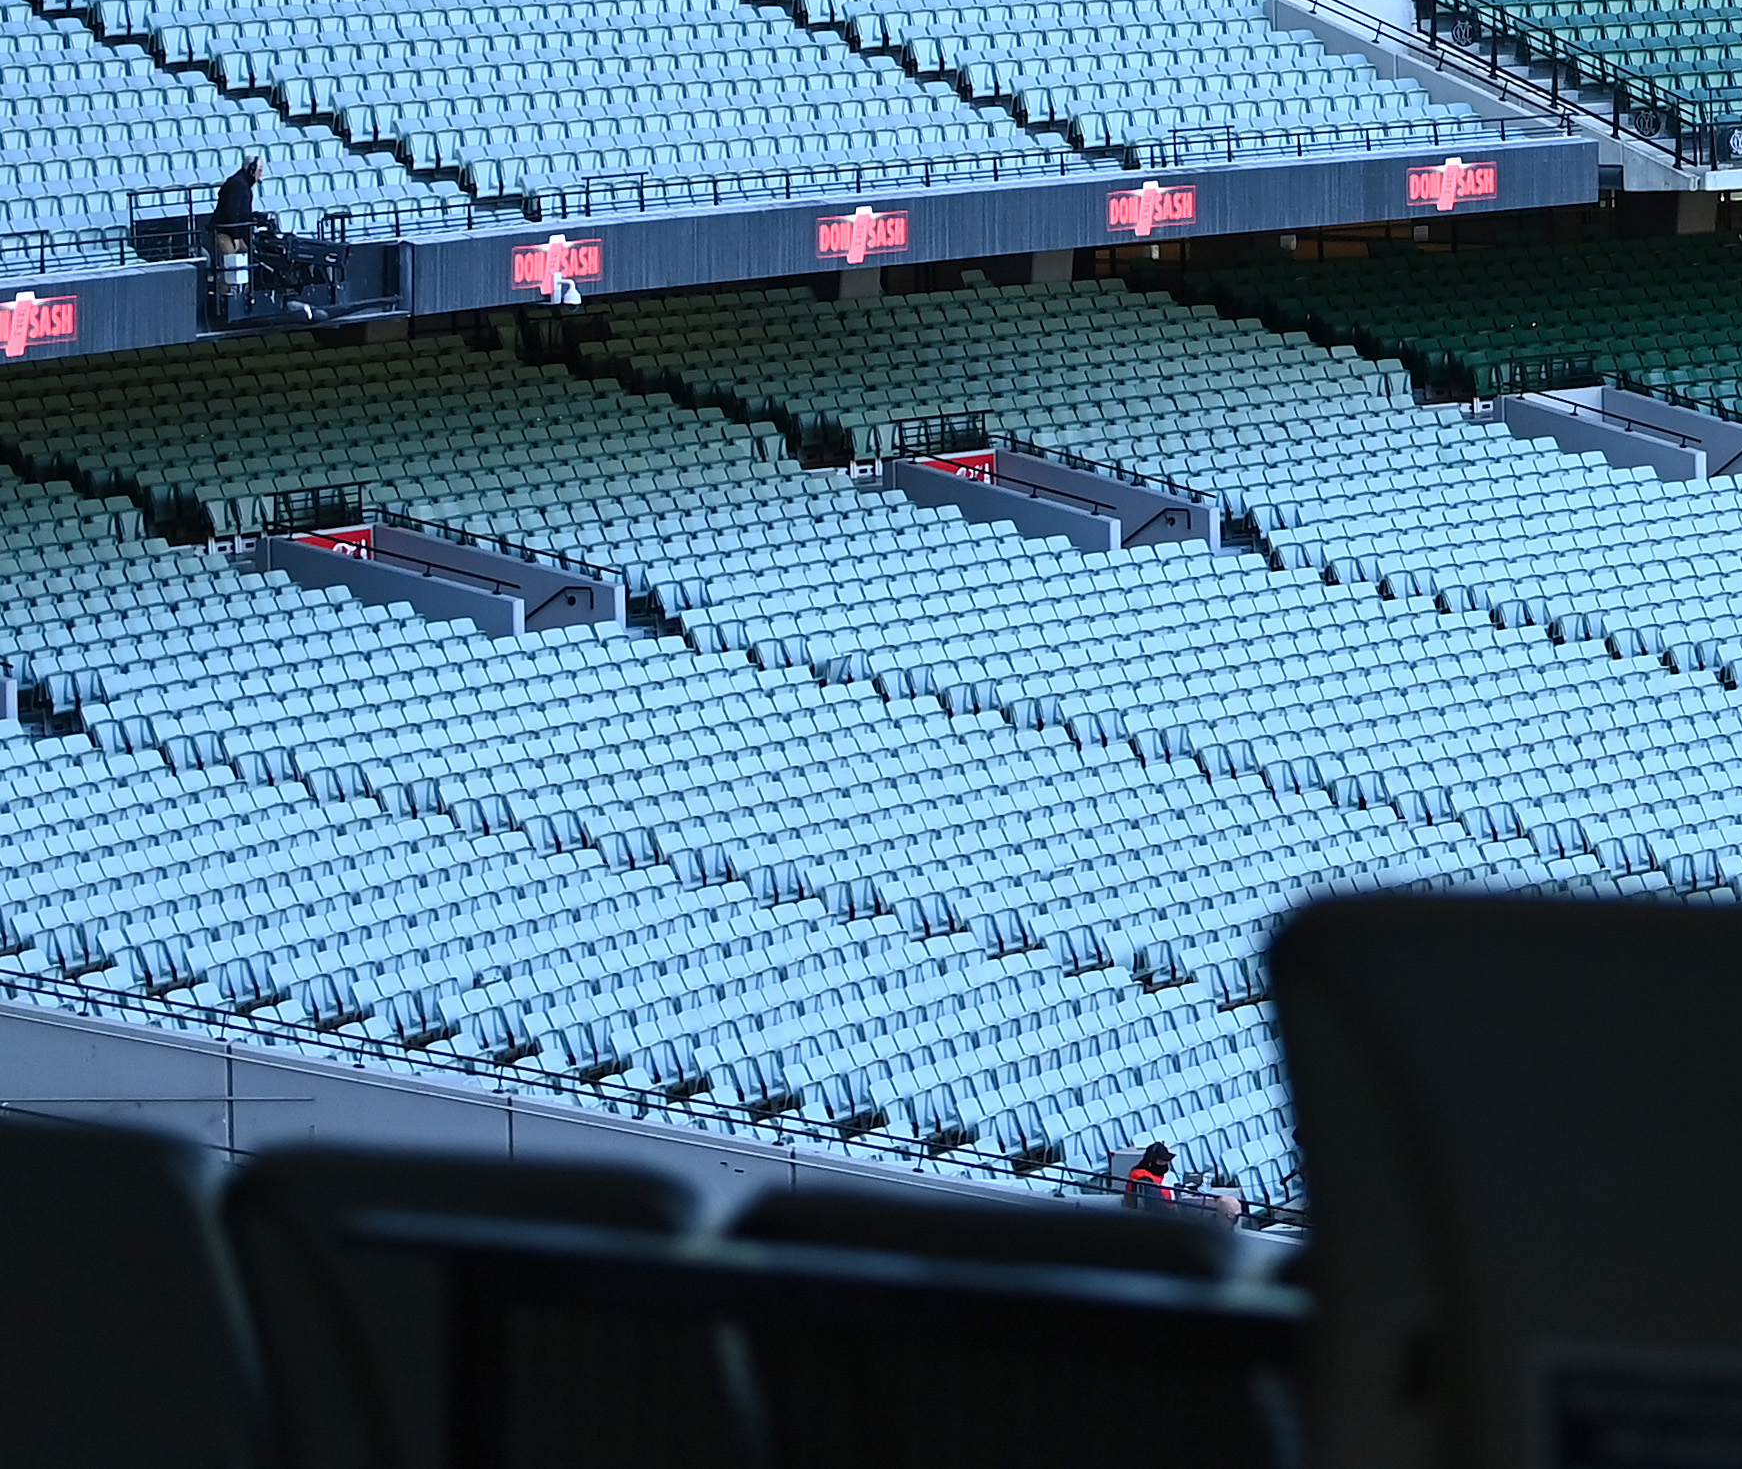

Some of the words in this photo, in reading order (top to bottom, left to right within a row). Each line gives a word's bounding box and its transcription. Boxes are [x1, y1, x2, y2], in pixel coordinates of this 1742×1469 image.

[1409, 172, 1442, 200] DON
[1457, 168, 1495, 197] SASH
[1109, 196, 1140, 225] DON
[1154, 192, 1193, 221] SASH
[819, 221, 852, 253] DON
[867, 217, 906, 248] SASH
[514, 251, 546, 283] DON
[561, 246, 600, 278] SASH
[29, 303, 74, 338] SASH
